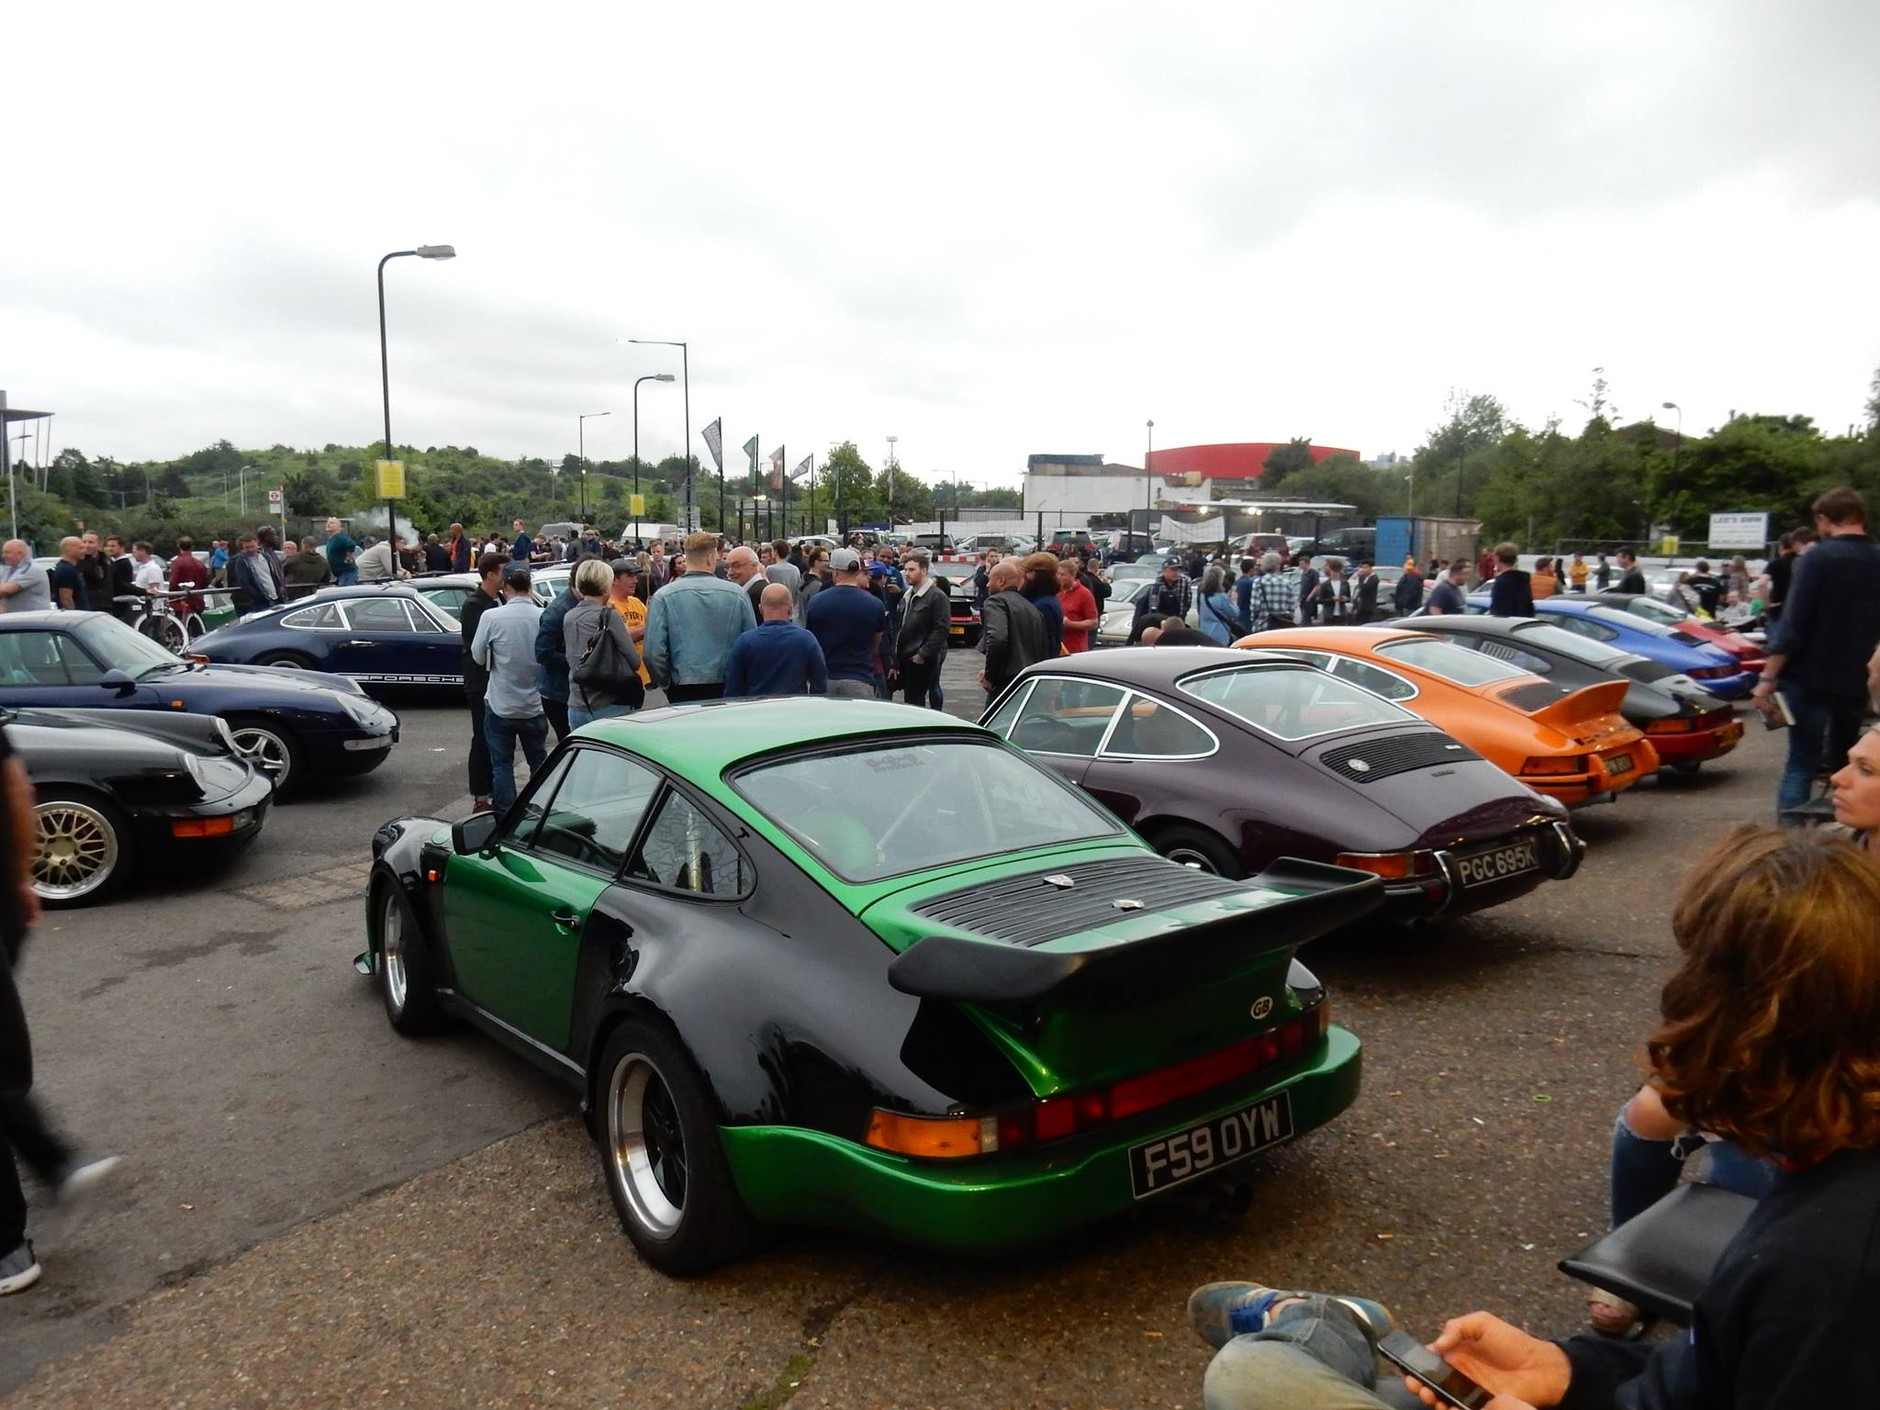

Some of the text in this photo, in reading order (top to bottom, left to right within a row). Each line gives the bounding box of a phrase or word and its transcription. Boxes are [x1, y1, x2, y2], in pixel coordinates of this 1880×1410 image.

[1459, 844, 1536, 884] PGC 695K
[1253, 999, 1270, 1017] GB
[1144, 1100, 1279, 1188] F59 OYW
